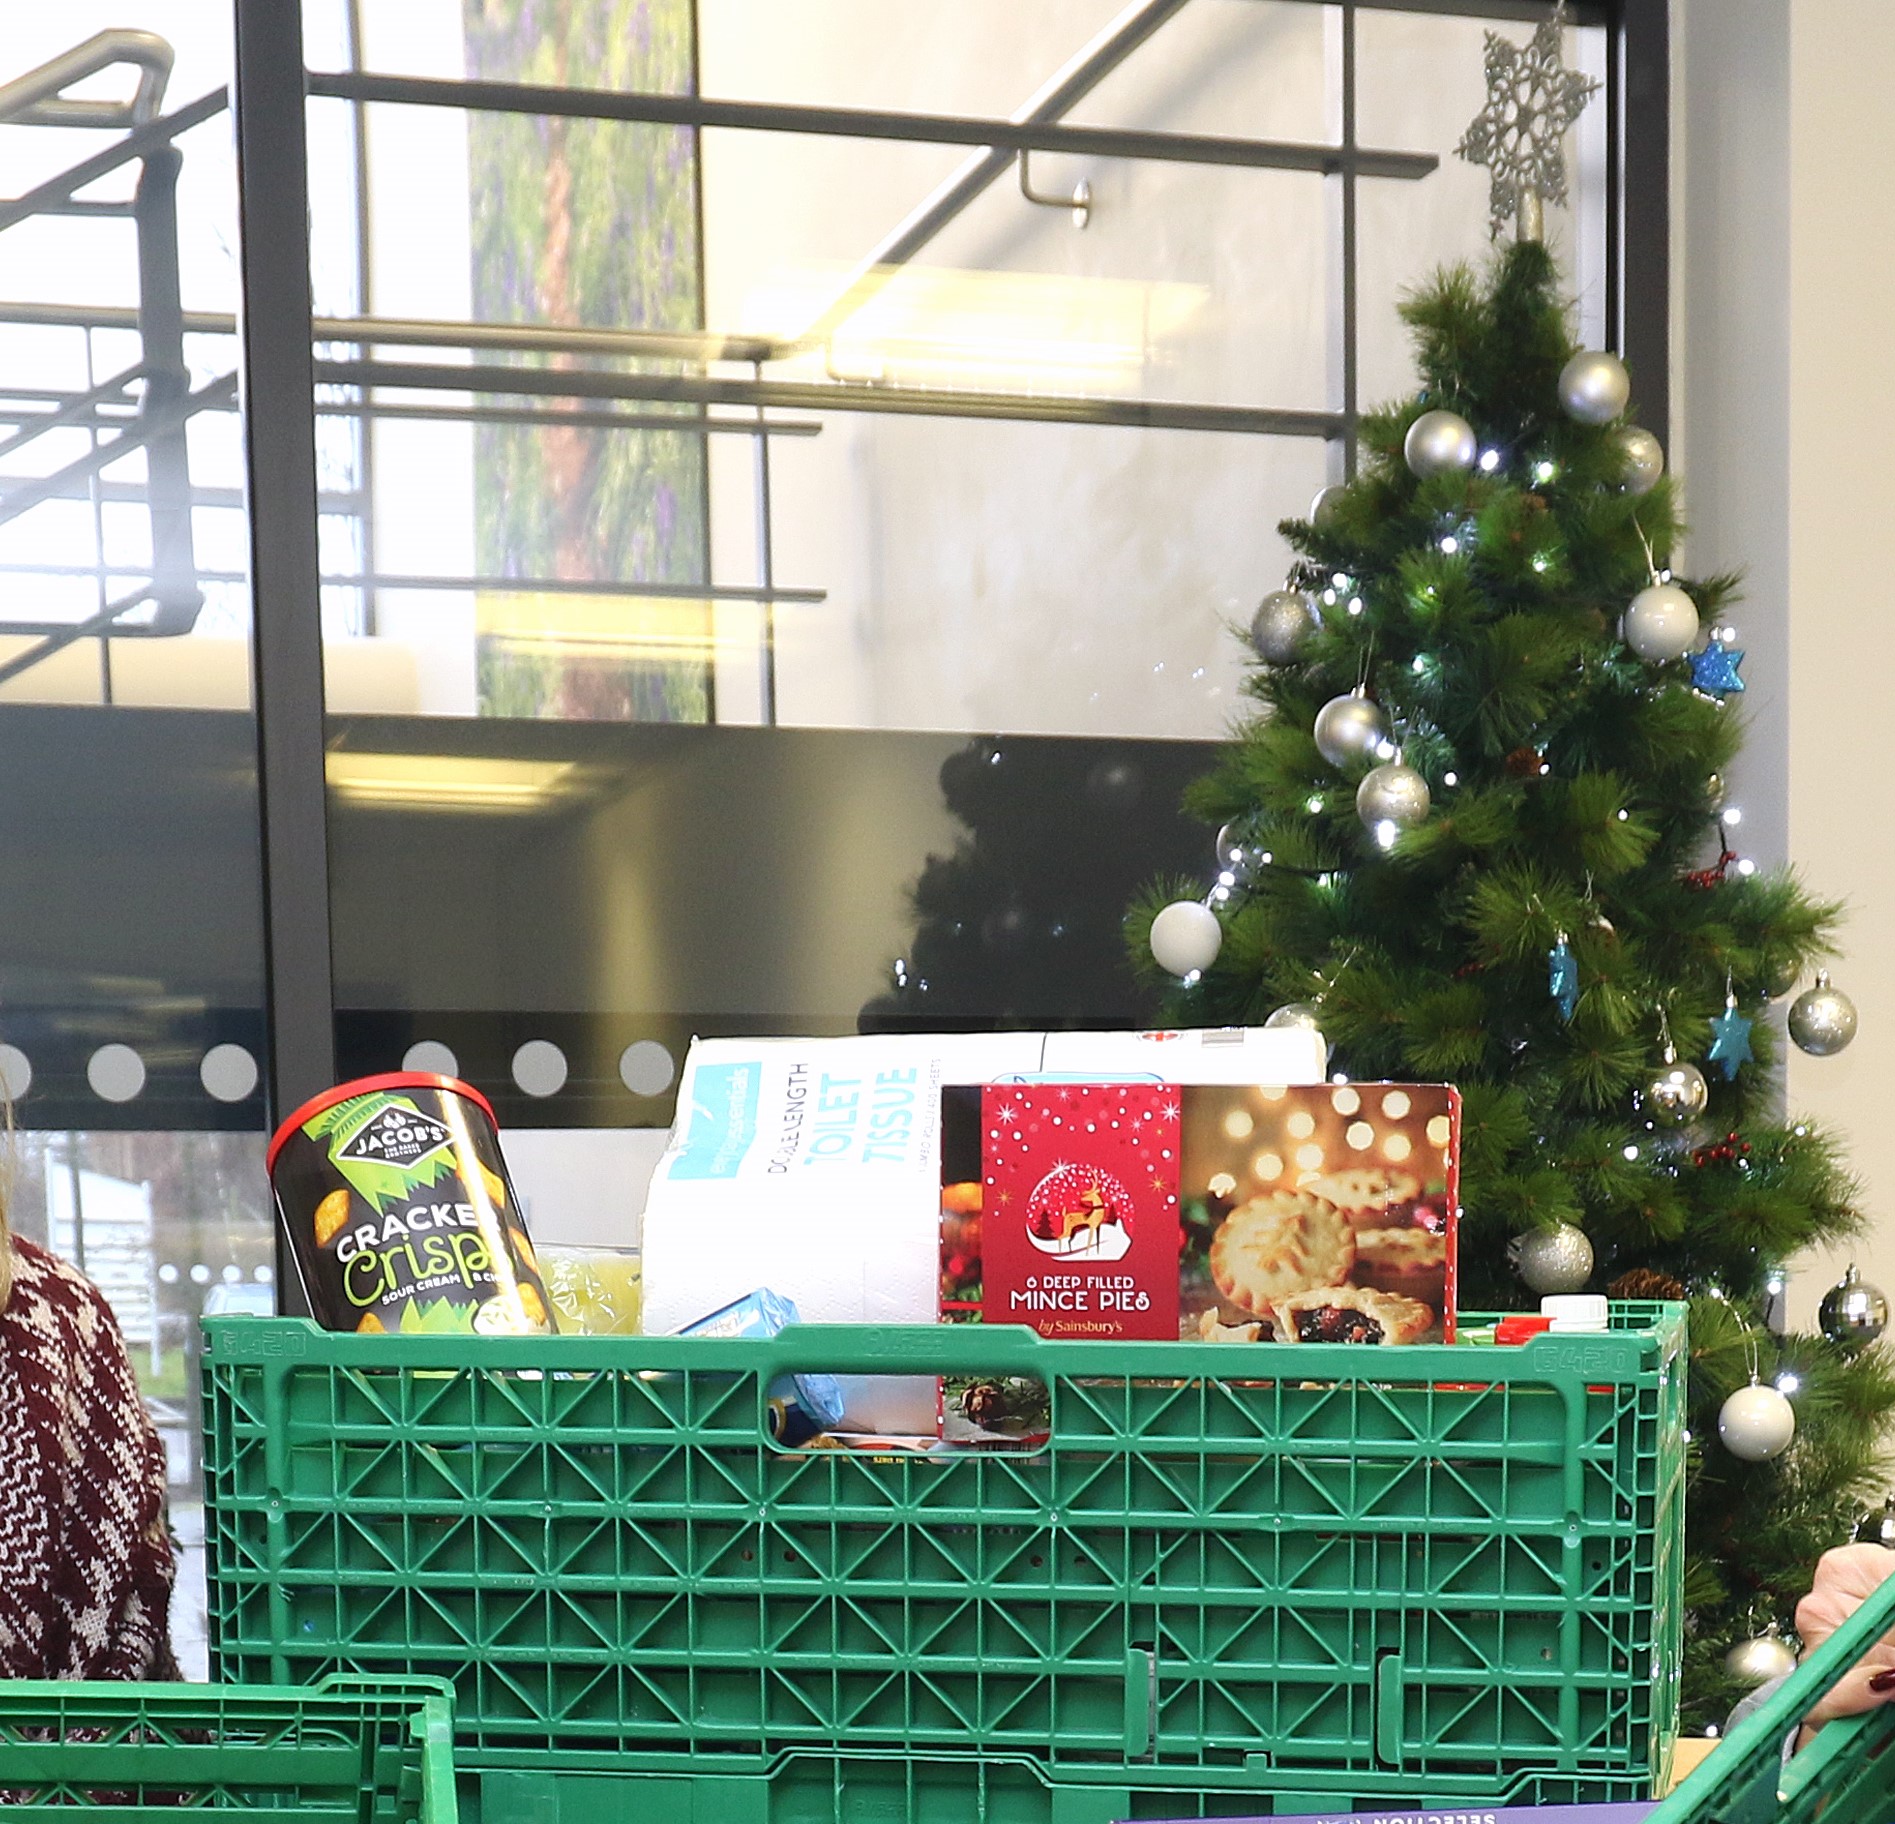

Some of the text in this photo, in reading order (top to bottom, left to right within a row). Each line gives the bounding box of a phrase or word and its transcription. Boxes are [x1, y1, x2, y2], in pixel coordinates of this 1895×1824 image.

[784, 1063, 808, 1131] LENGTH
[803, 1073, 861, 1165] TOILET
[862, 1068, 917, 1163] TISSUE
[356, 1125, 443, 1155] JACOB'S
[337, 1203, 500, 1263] CRACKE
[344, 1231, 514, 1306] Crisp
[382, 1285, 415, 1305] SOUR
[416, 1274, 461, 1291] CREAM
[1026, 1276, 1134, 1289] 6 DEEP FILLED
[1010, 1290, 1150, 1311] MINCE PIES
[1038, 1319, 1123, 1335] by Sainsbury's
